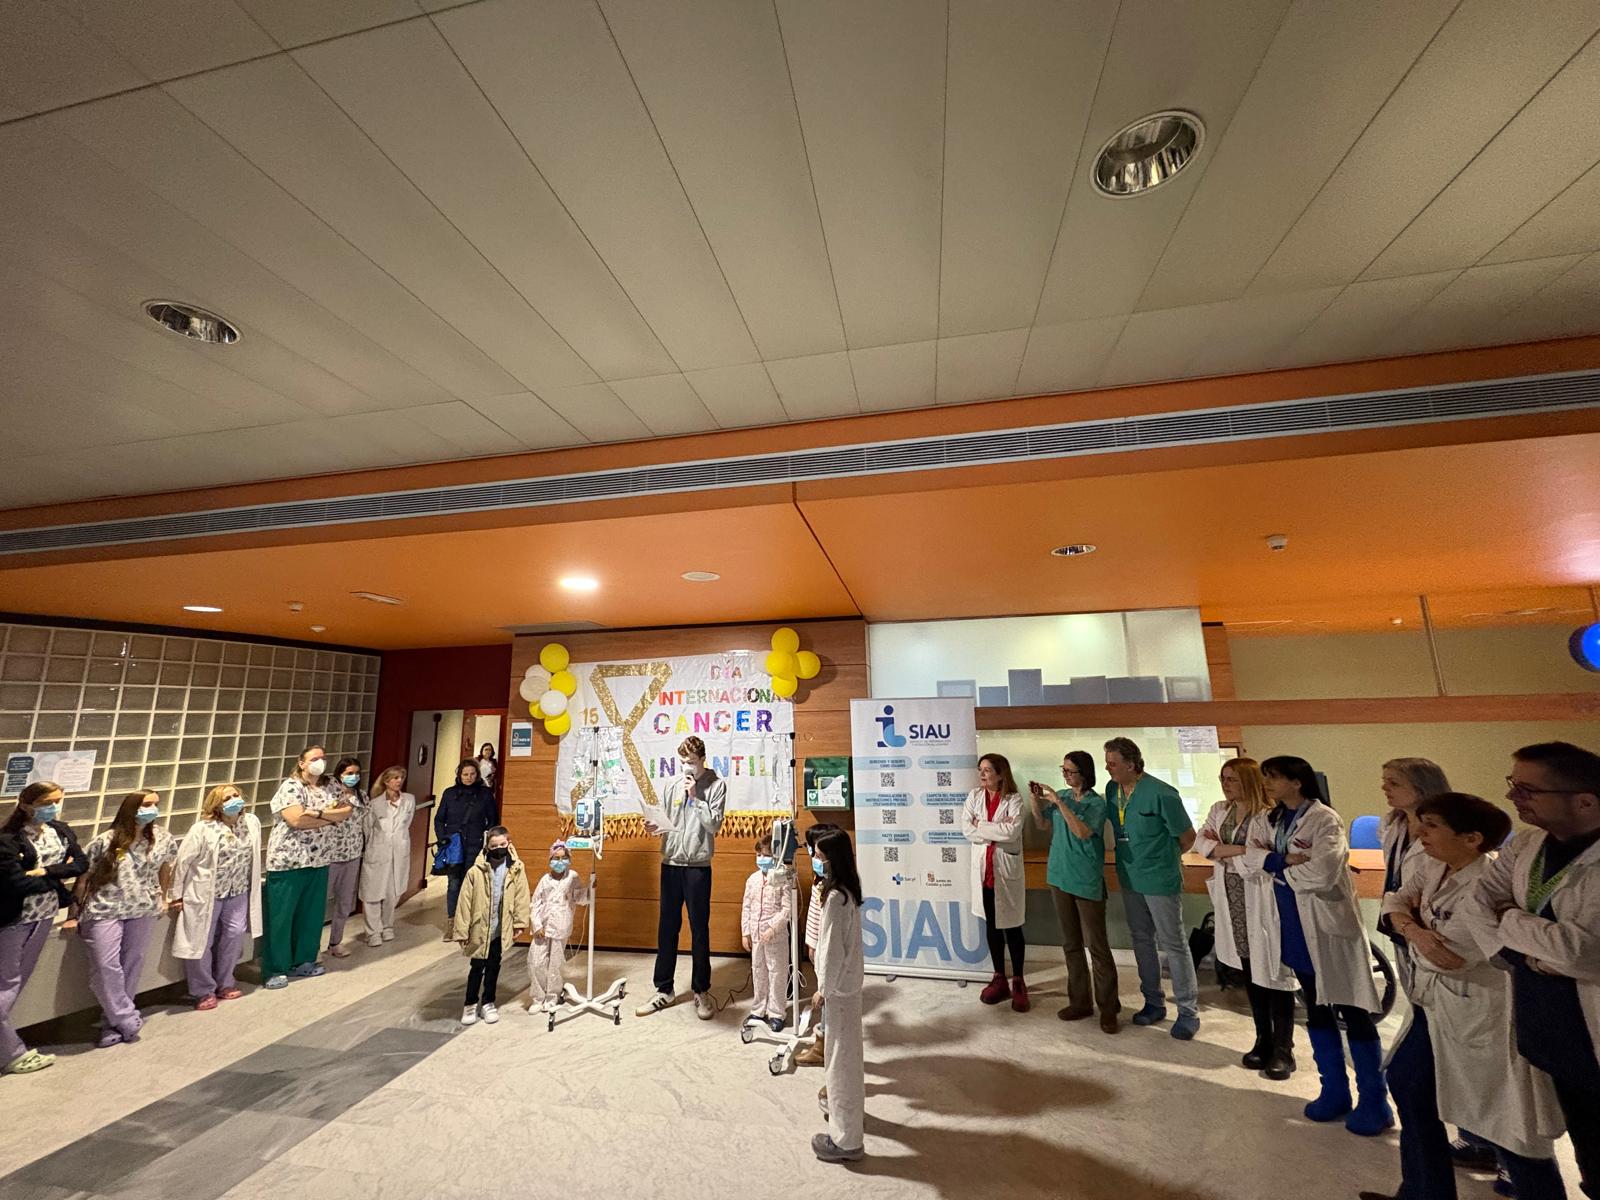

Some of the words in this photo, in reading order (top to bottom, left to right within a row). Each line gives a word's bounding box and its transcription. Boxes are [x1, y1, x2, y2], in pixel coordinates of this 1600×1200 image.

[579, 707, 599, 726] 15
[653, 709, 773, 735] CANCER
[909, 724, 951, 739] SIAU
[649, 754, 772, 779] INNTIL
[861, 897, 990, 964] SIAU
